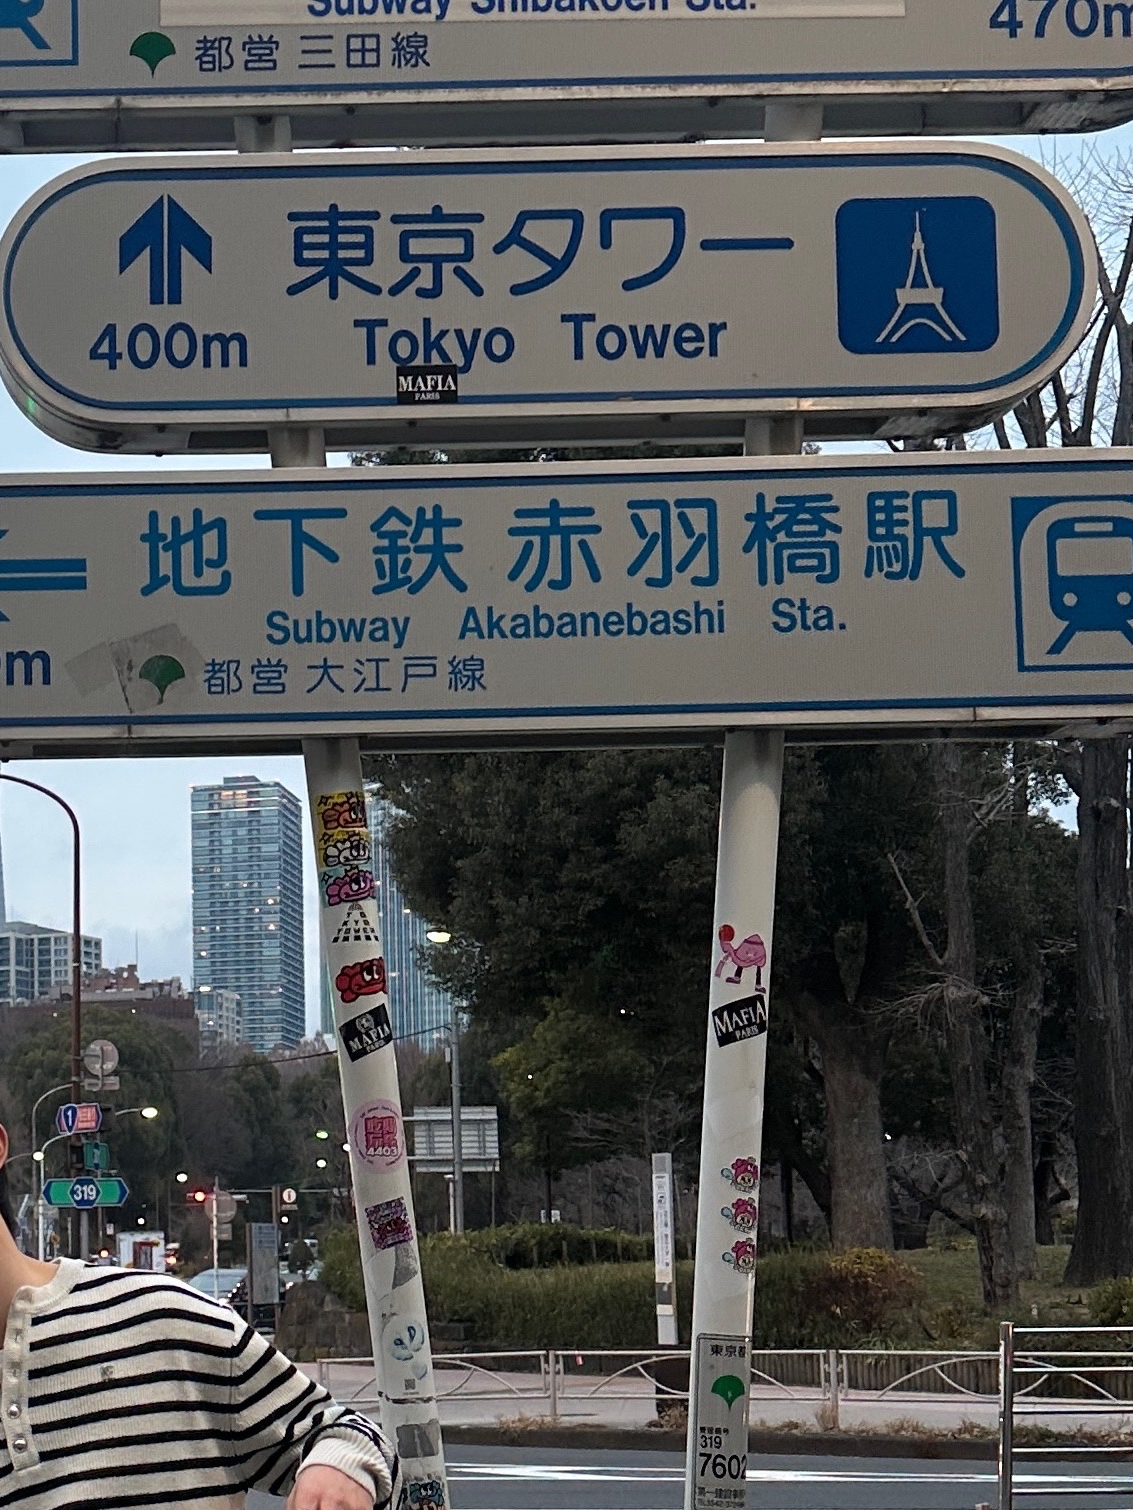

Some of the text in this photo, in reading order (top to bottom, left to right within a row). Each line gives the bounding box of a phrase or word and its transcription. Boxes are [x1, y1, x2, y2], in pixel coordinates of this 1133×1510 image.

[194, 31, 430, 73] 都営 三田線
[285, 202, 795, 300] 東京タワー
[88, 321, 249, 370] 400m
[353, 312, 728, 374] Tokyo Tower
[398, 374, 457, 392] MAFIA
[139, 489, 966, 598] 地下鉄 赤羽橋駅
[266, 597, 848, 649] Subway Akabanebashi Sta.
[202, 654, 488, 696] 都営 大江戸線
[713, 1000, 767, 1037] MAFIA
[735, 1025, 759, 1041] PARIS
[348, 1023, 391, 1053] MAFIA
[366, 1146, 398, 1157] 4403
[73, 1184, 97, 1201] 319
[700, 1435, 723, 1450] 319
[698, 1452, 748, 1480] 7602
